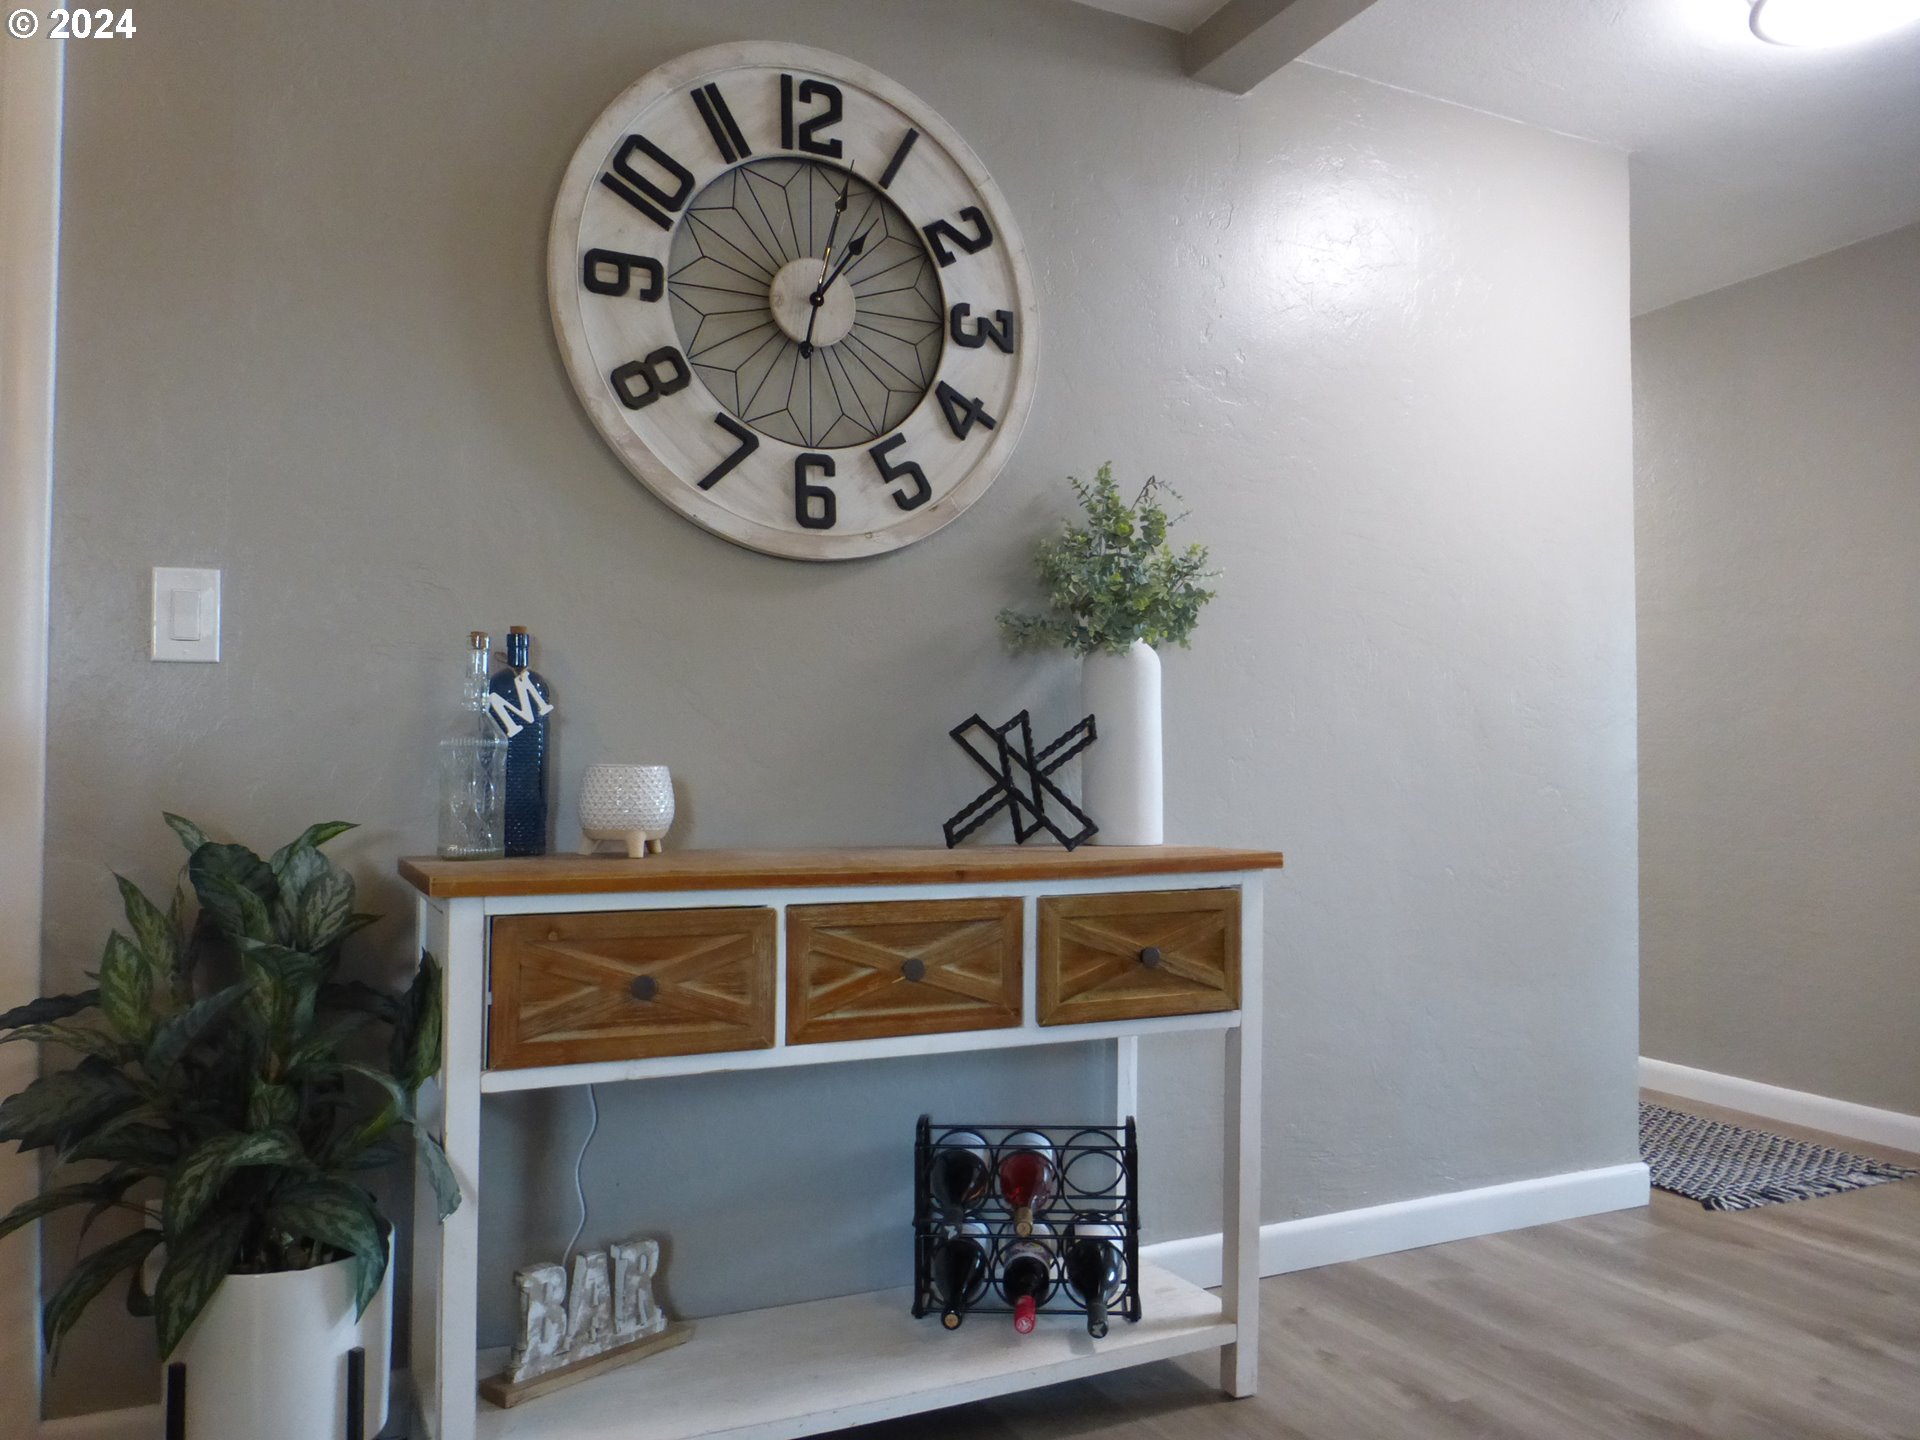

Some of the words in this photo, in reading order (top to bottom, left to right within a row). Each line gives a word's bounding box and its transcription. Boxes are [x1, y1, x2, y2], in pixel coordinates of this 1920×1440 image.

[690, 82, 752, 164] 11
[780, 73, 843, 159] 12
[600, 134, 695, 232] 10
[879, 127, 920, 189] 1
[922, 205, 993, 268] 2
[583, 247, 665, 303] 9
[950, 302, 1014, 354] 3
[610, 345, 691, 410] 8
[935, 380, 997, 441] 4
[696, 411, 759, 491] 7
[869, 432, 932, 511] 5
[794, 452, 837, 530] 6
[488, 671, 554, 738] M
[511, 1239, 668, 1384] BAR
